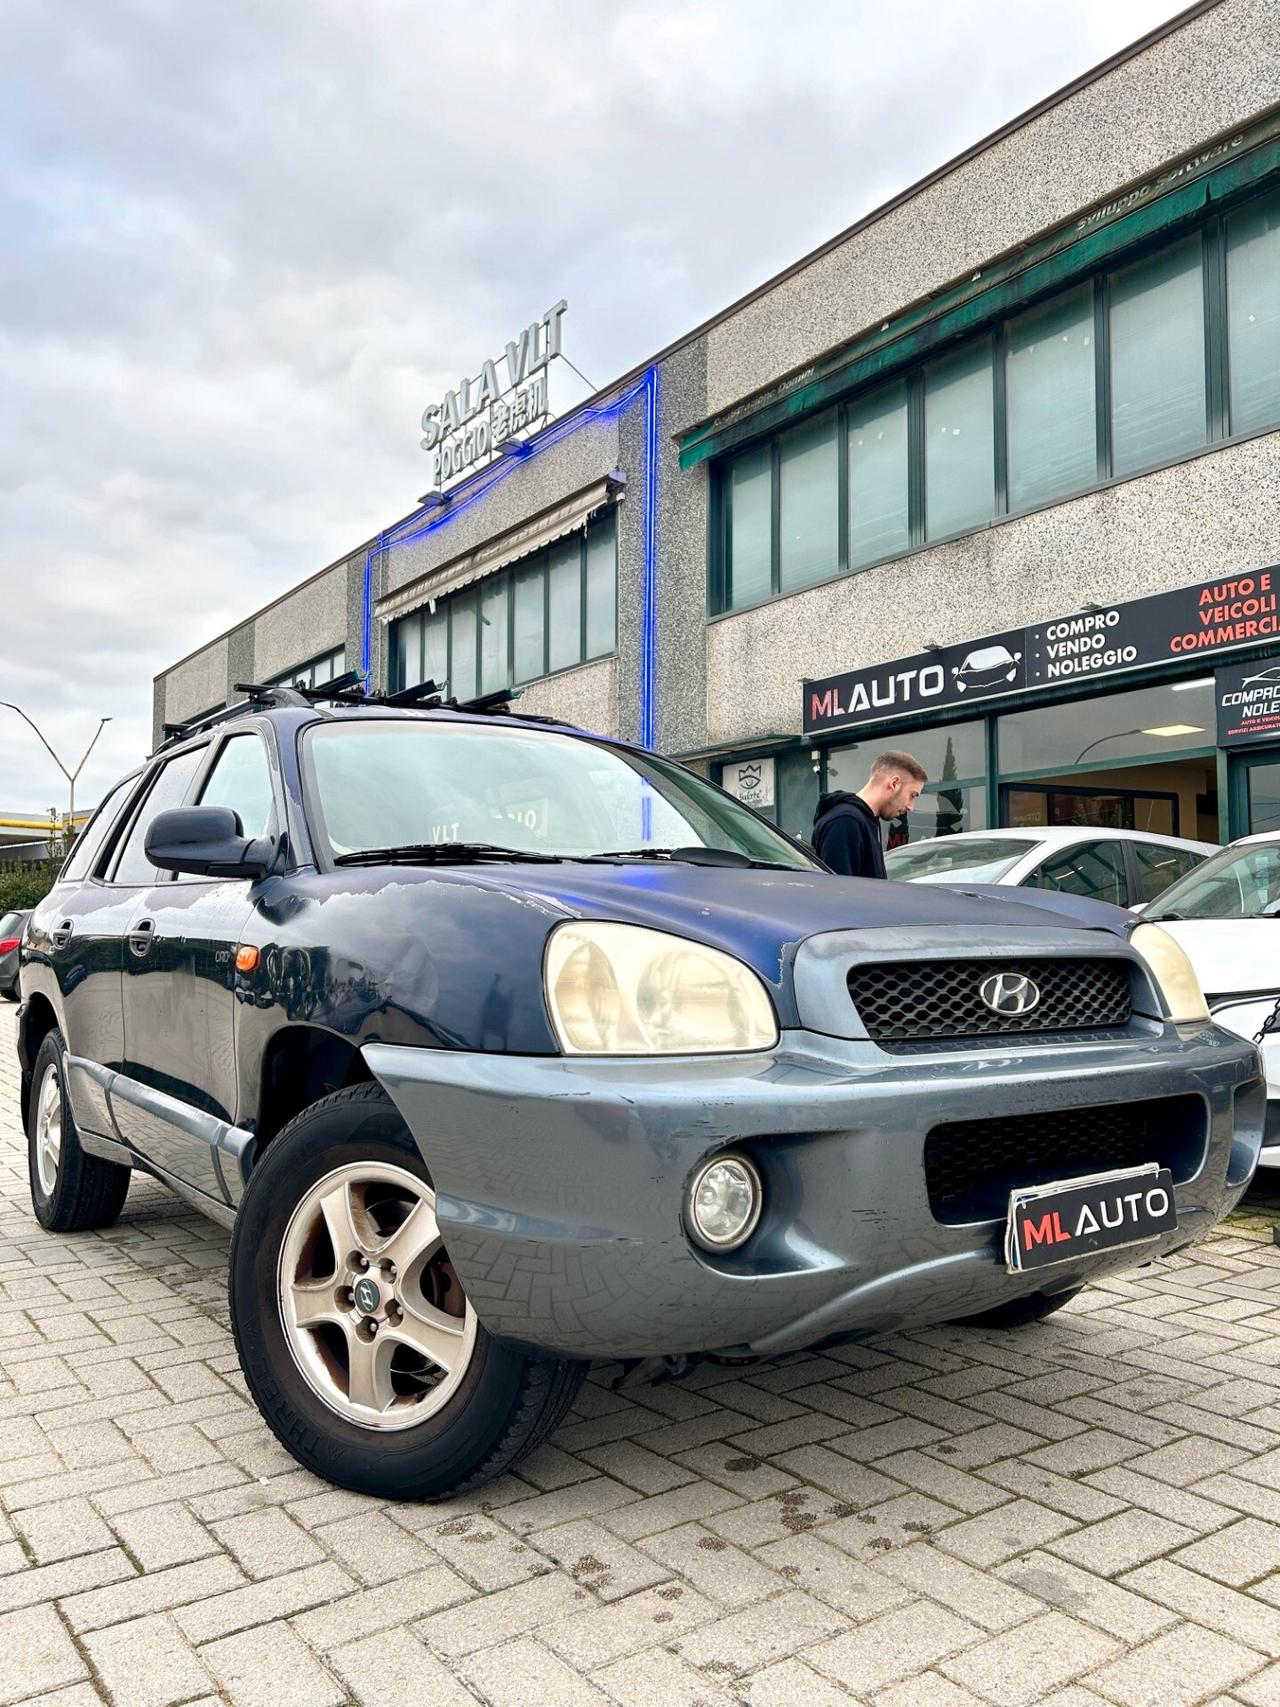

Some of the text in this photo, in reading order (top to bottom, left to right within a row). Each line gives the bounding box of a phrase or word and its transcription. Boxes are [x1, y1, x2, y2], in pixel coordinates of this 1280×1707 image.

[420, 299, 568, 451] SALA VLT
[433, 420, 492, 486] POGGIO
[1199, 573, 1271, 606] AUTO E
[1046, 610, 1120, 640] COMPRO
[1199, 594, 1277, 625] VEICOLI
[1046, 633, 1106, 659] VENDO
[1170, 615, 1280, 653] COMMERCI
[1047, 645, 1138, 678] NOLEGGIO
